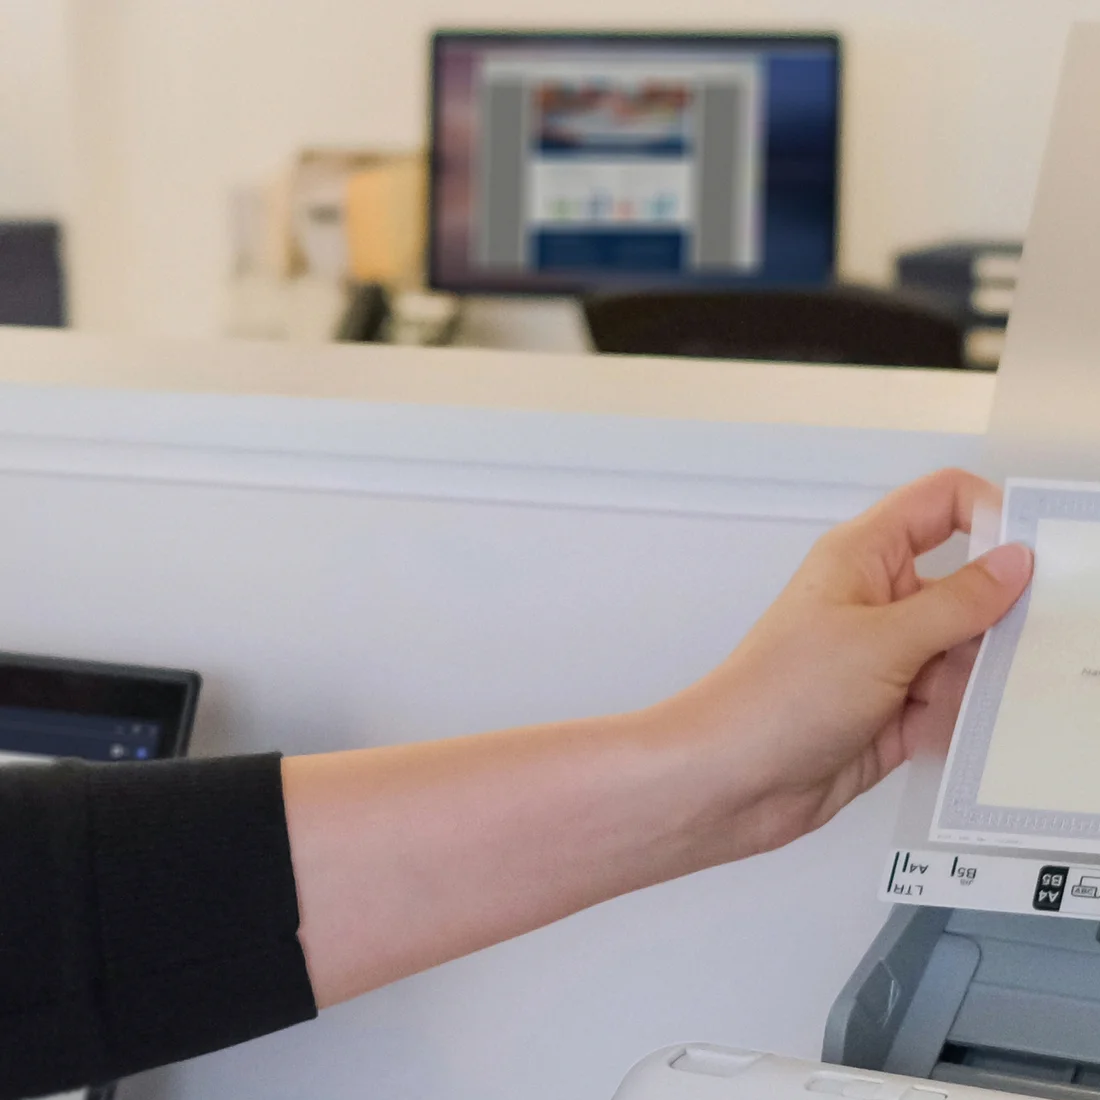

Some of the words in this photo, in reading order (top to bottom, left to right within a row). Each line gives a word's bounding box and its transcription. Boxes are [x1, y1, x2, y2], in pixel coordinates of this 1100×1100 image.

[908, 863, 929, 874] A4
[957, 867, 977, 879] B5
[1042, 873, 1063, 886] B5
[893, 884, 924, 896] LTR
[1038, 890, 1060, 903] A4
